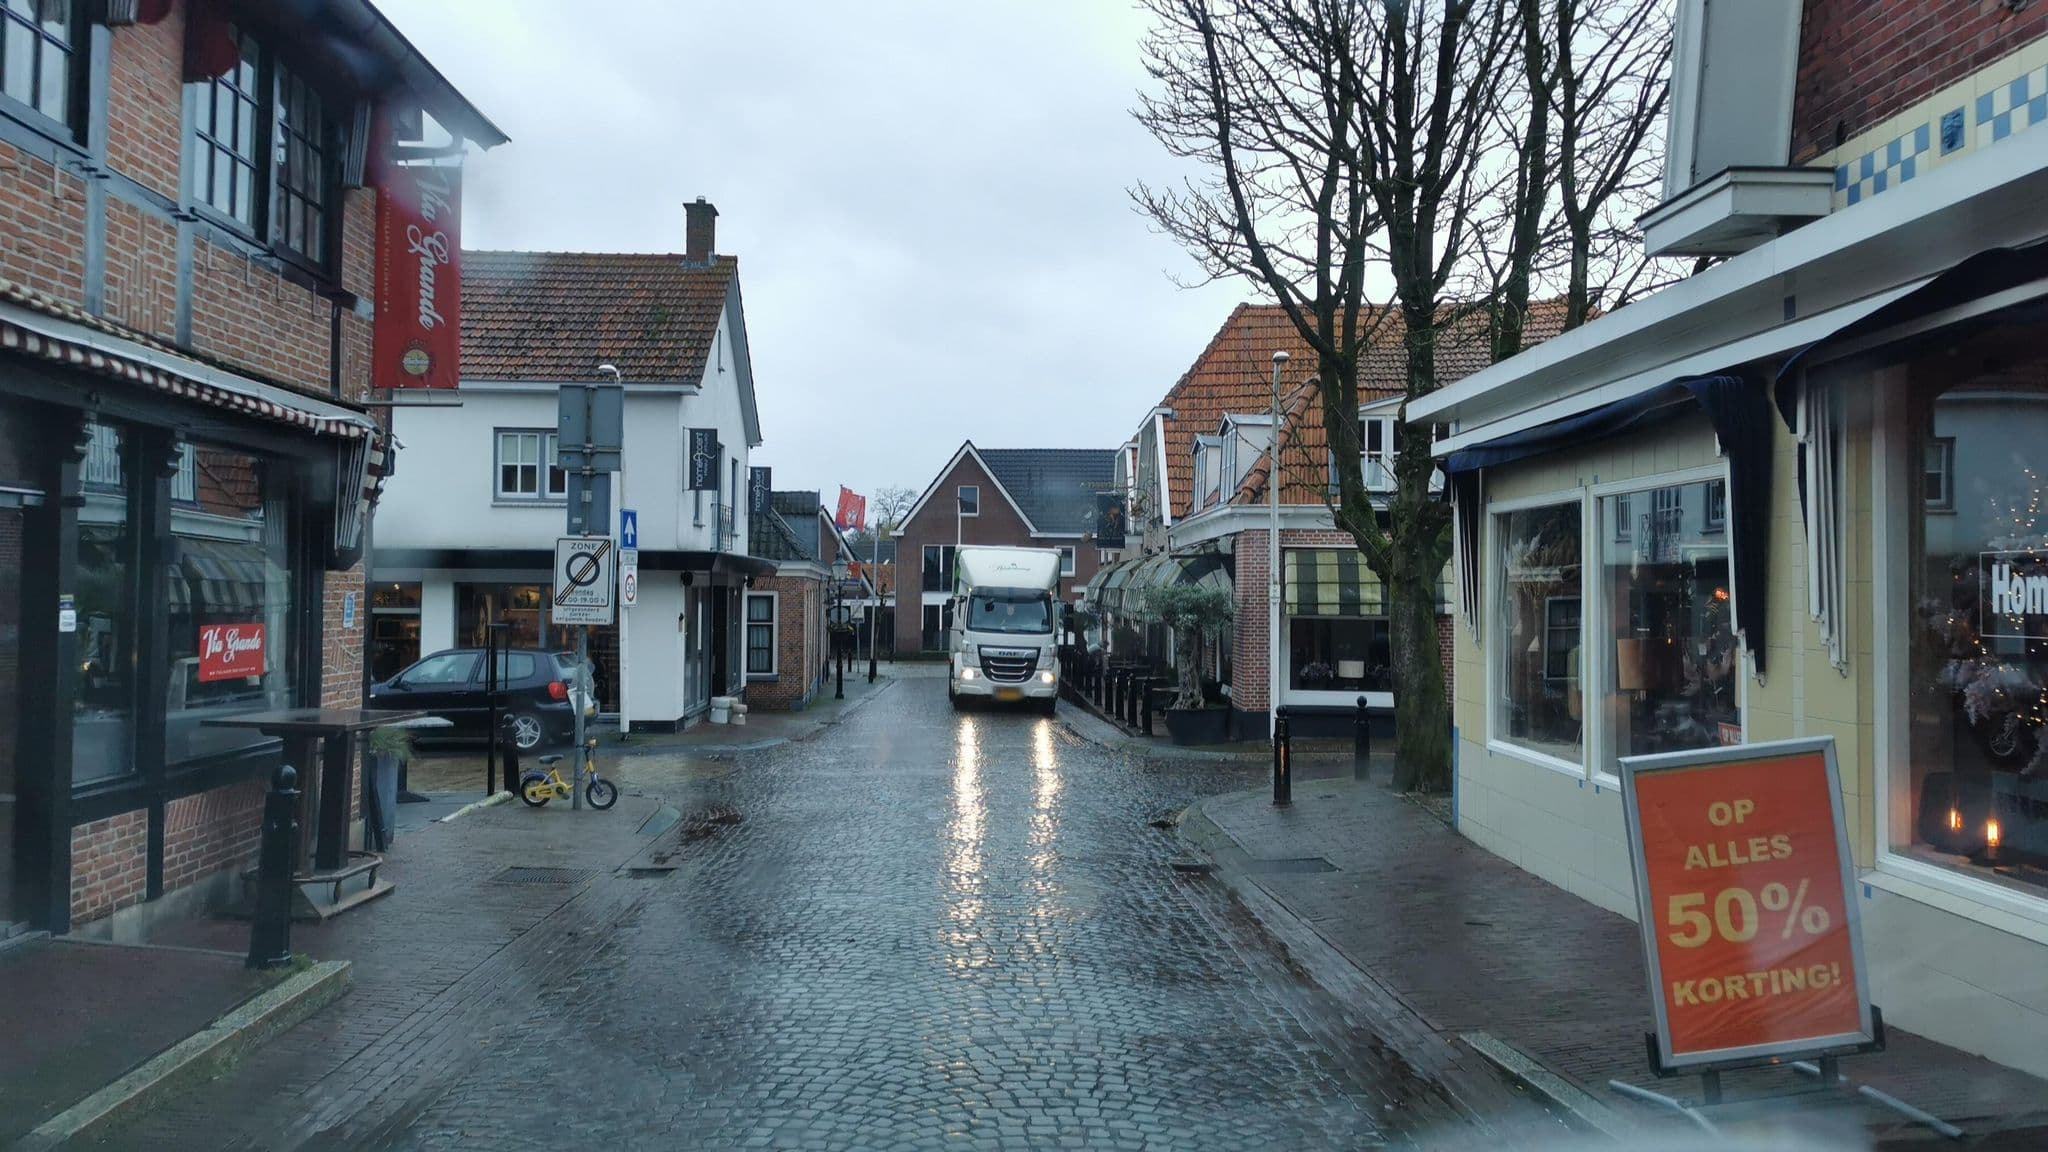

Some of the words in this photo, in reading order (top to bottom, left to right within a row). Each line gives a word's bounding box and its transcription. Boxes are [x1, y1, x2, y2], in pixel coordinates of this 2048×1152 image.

[407, 225, 449, 331] Grande
[203, 627, 223, 659] Via
[223, 628, 262, 663] Grande
[1708, 799, 1754, 826] OP
[1684, 834, 1792, 870] ALLES
[1668, 879, 1830, 948] 50%
[1672, 961, 1841, 1007] KORTING!
